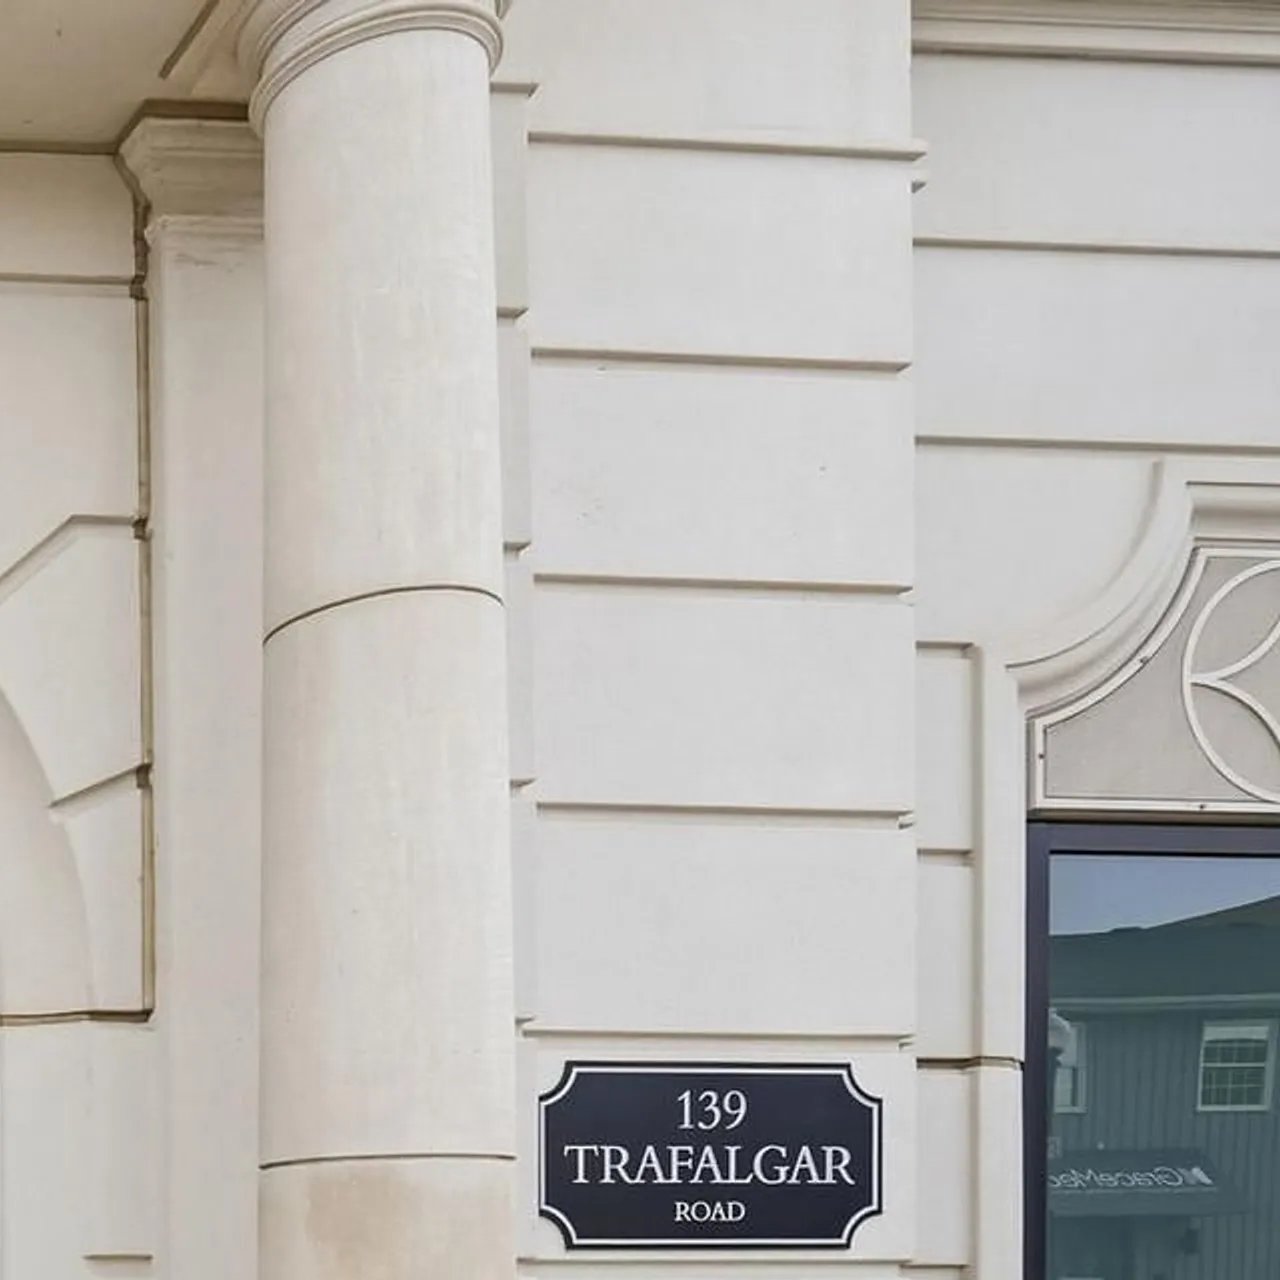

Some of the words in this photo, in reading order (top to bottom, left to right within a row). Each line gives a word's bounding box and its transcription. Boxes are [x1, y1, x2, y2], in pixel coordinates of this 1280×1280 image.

[676, 1090, 748, 1130] 139
[563, 1144, 856, 1185] TRAFALGAR
[674, 1201, 746, 1222] ROAD
